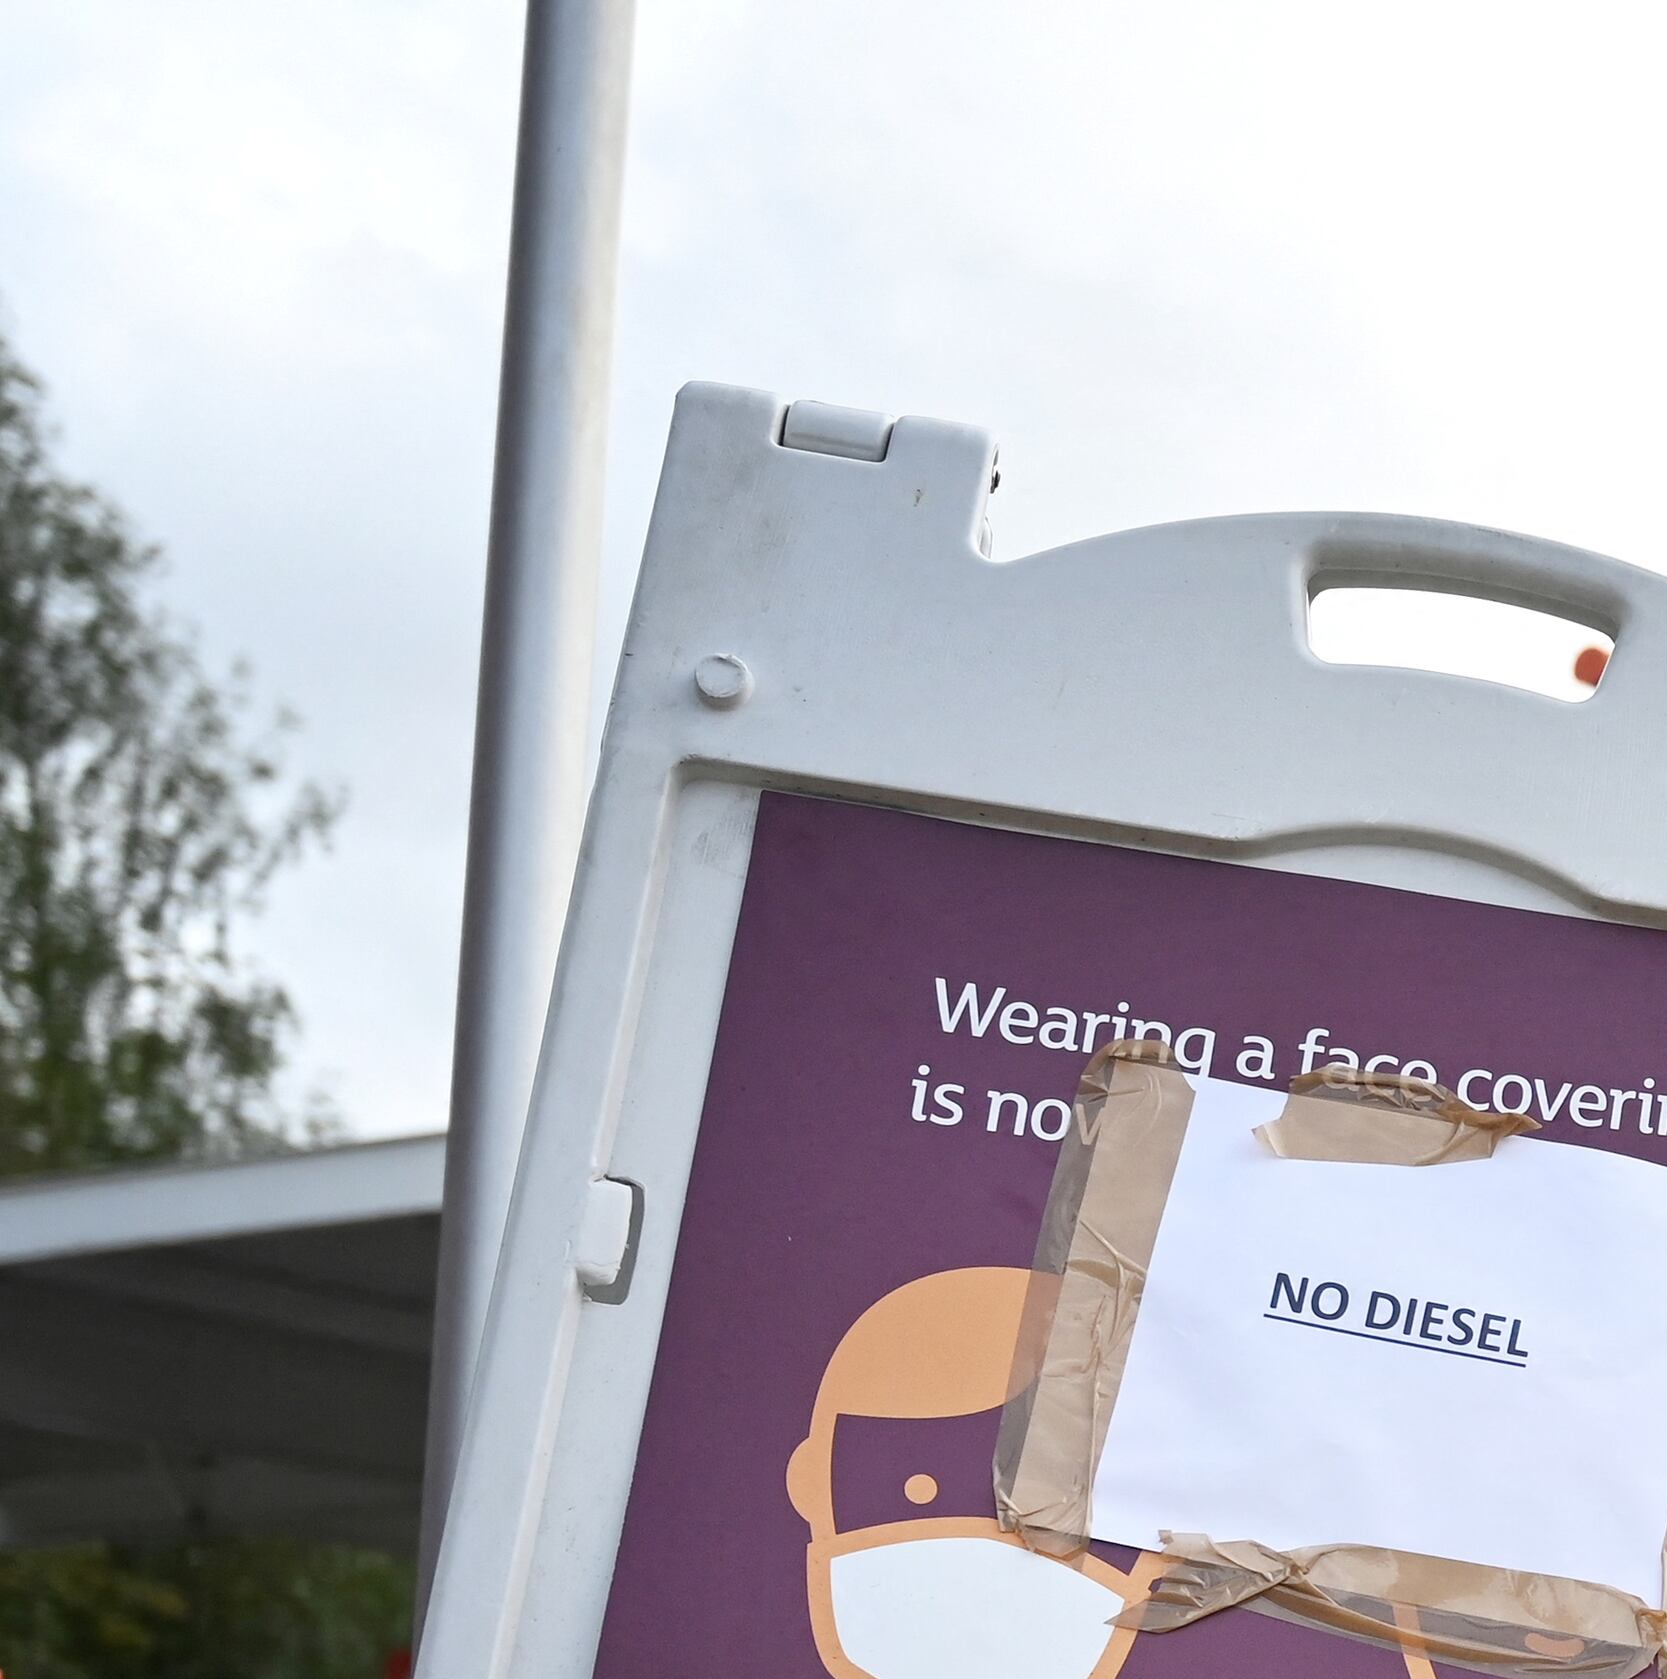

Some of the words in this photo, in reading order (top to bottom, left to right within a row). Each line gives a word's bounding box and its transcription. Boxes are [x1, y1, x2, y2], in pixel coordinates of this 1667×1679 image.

[934, 976, 1217, 1077] Wearing
[1235, 1033, 1276, 1080] a
[1297, 1027, 1438, 1100] face
[910, 1064, 965, 1127] is
[1269, 1272, 1350, 1321] NO
[1364, 1290, 1529, 1358] DIESEL
